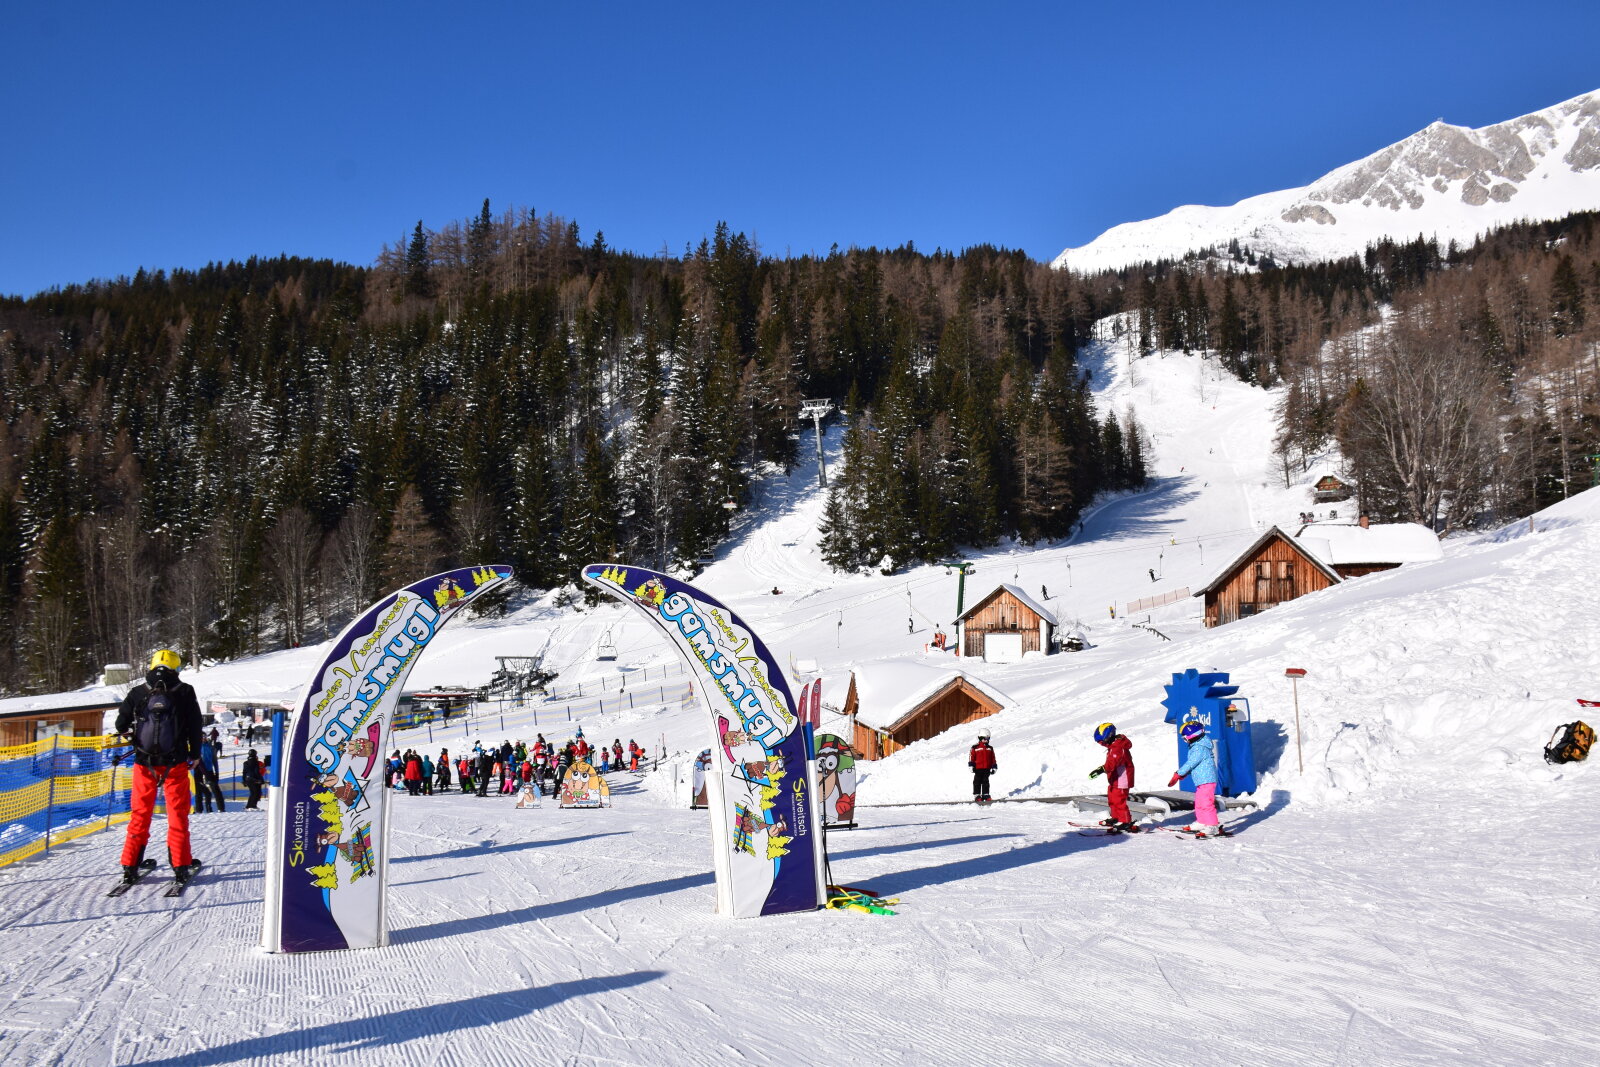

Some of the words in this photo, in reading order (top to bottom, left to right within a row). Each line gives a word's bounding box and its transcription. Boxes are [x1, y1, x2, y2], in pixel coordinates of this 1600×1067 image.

[662, 593, 784, 750] gamsmugl
[289, 801, 305, 868] Skiveitsch
[793, 777, 806, 836] Skiveitsch
